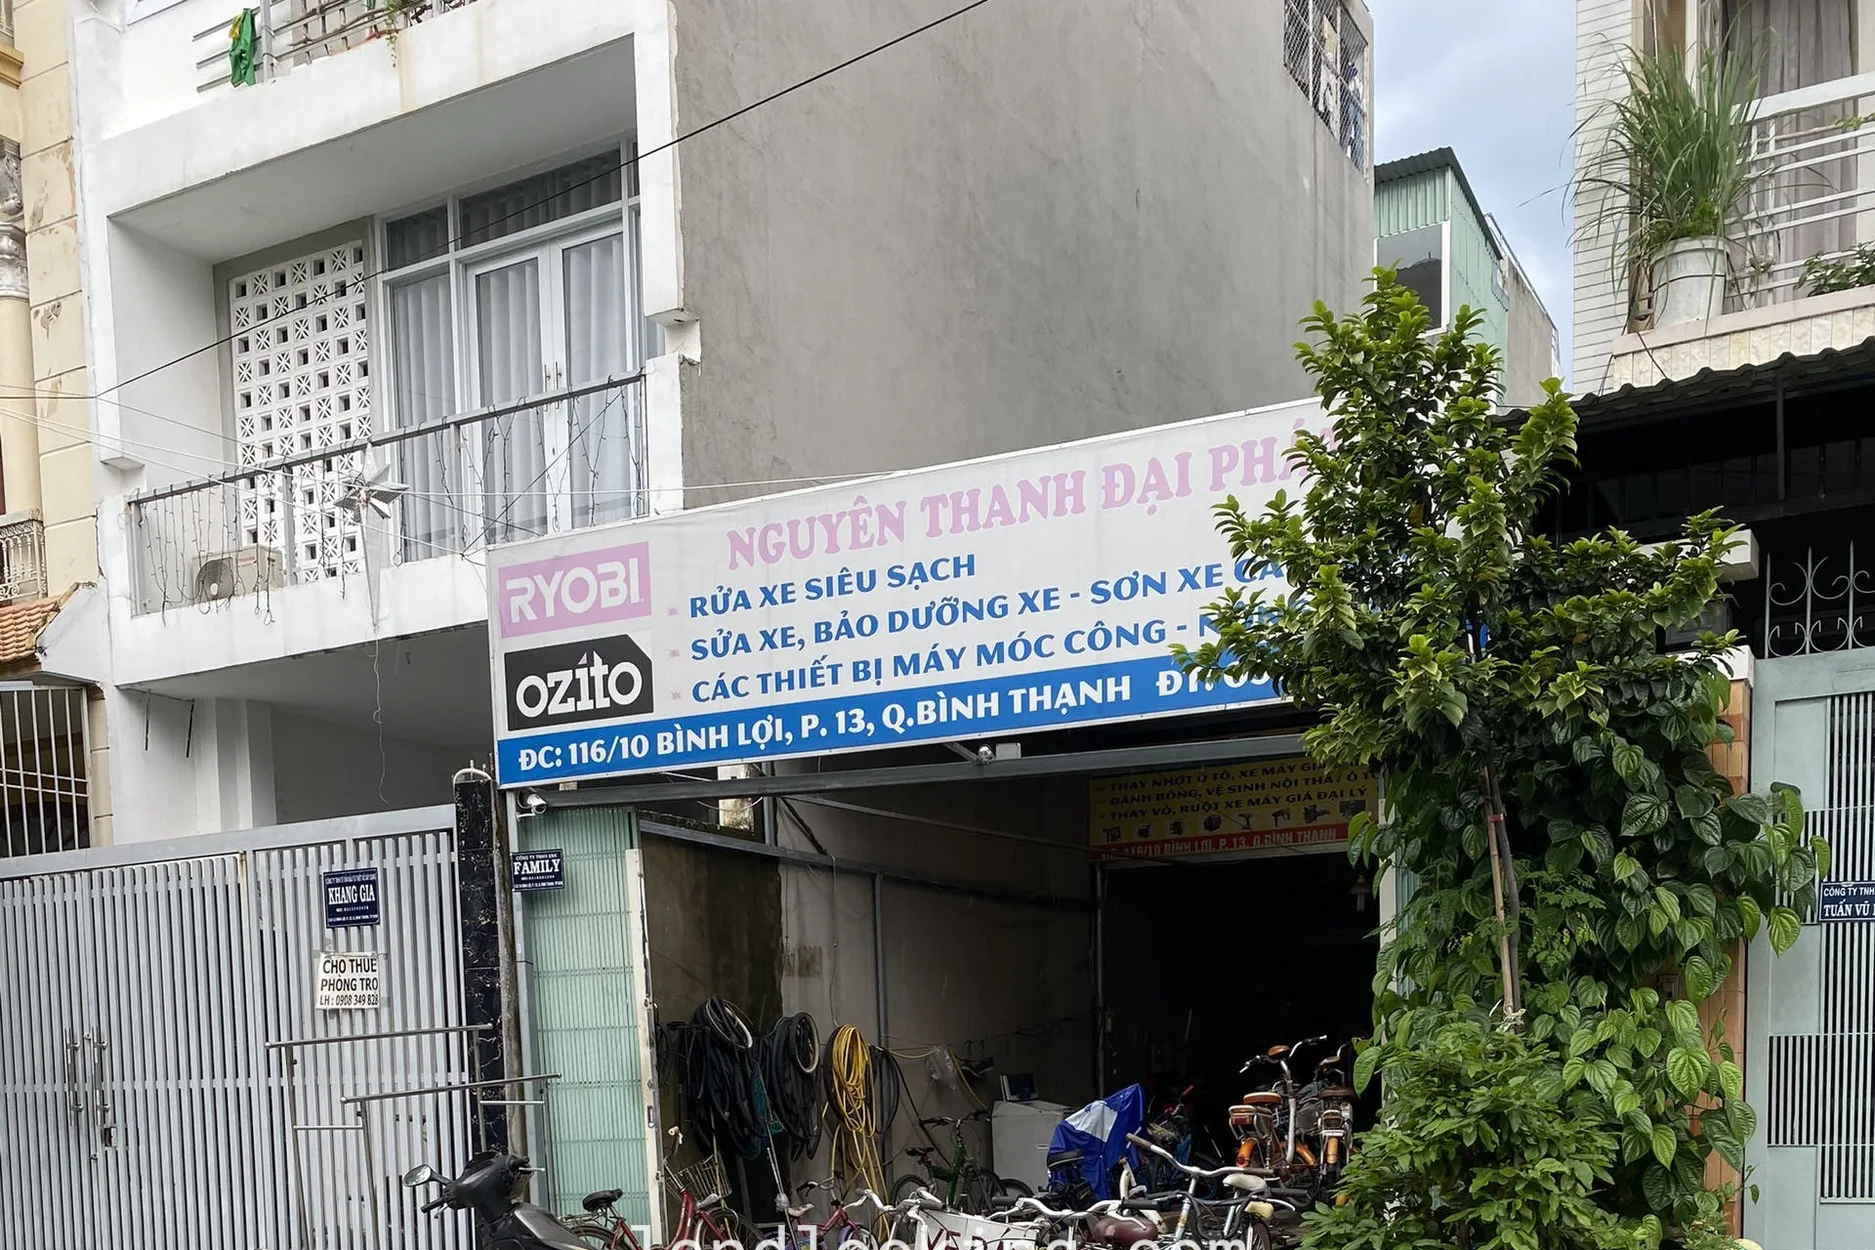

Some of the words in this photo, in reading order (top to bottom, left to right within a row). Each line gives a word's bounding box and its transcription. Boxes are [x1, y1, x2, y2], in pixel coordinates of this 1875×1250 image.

[727, 495, 907, 570] NGUYÊN
[920, 470, 1087, 538] THANH
[1101, 451, 1193, 516] ĐẠI
[1208, 418, 1340, 491] PHÁ
[506, 557, 641, 623] RYOBI
[690, 585, 752, 618] RỬA
[759, 582, 797, 608] XE
[805, 567, 877, 600] SIÊU
[887, 554, 975, 590] SẠCH
[691, 628, 752, 661] SỬA
[759, 626, 806, 652] XE,
[814, 610, 879, 644] BẢO
[888, 595, 1009, 634] DƯỠNG
[1018, 587, 1061, 615] XE
[1090, 570, 1167, 604] SƠN
[1177, 563, 1224, 592] XE
[692, 672, 750, 703] CÁC
[756, 654, 844, 695] THIẾT
[852, 657, 883, 687] BỊ
[893, 642, 967, 677] MÁY
[976, 631, 1056, 667] MÓC
[1064, 619, 1167, 655] CÔNG
[518, 746, 562, 771] ĐC:
[568, 734, 649, 765] 116/10
[656, 724, 728, 755] BÌNH
[737, 714, 793, 750] LỢI,
[801, 714, 827, 739] P.
[835, 708, 875, 737] 13,
[882, 691, 999, 734] Q.BÌNH
[1008, 675, 1131, 715] THẠNH
[1240, 766, 1260, 778] XE
[1227, 783, 1266, 795] SINH
[1225, 800, 1243, 809] XE
[513, 859, 561, 875] FAMILY
[328, 884, 358, 905] KHANG
[359, 883, 376, 903] GIA
[1823, 886, 1846, 897] CÔNG
[1847, 887, 1858, 896] TY
[1823, 898, 1853, 917] TUẤN
[1855, 900, 1870, 916] VŨ
[322, 959, 347, 974] CHO
[320, 973, 357, 992] PHÒNG
[320, 995, 330, 1006] LH
